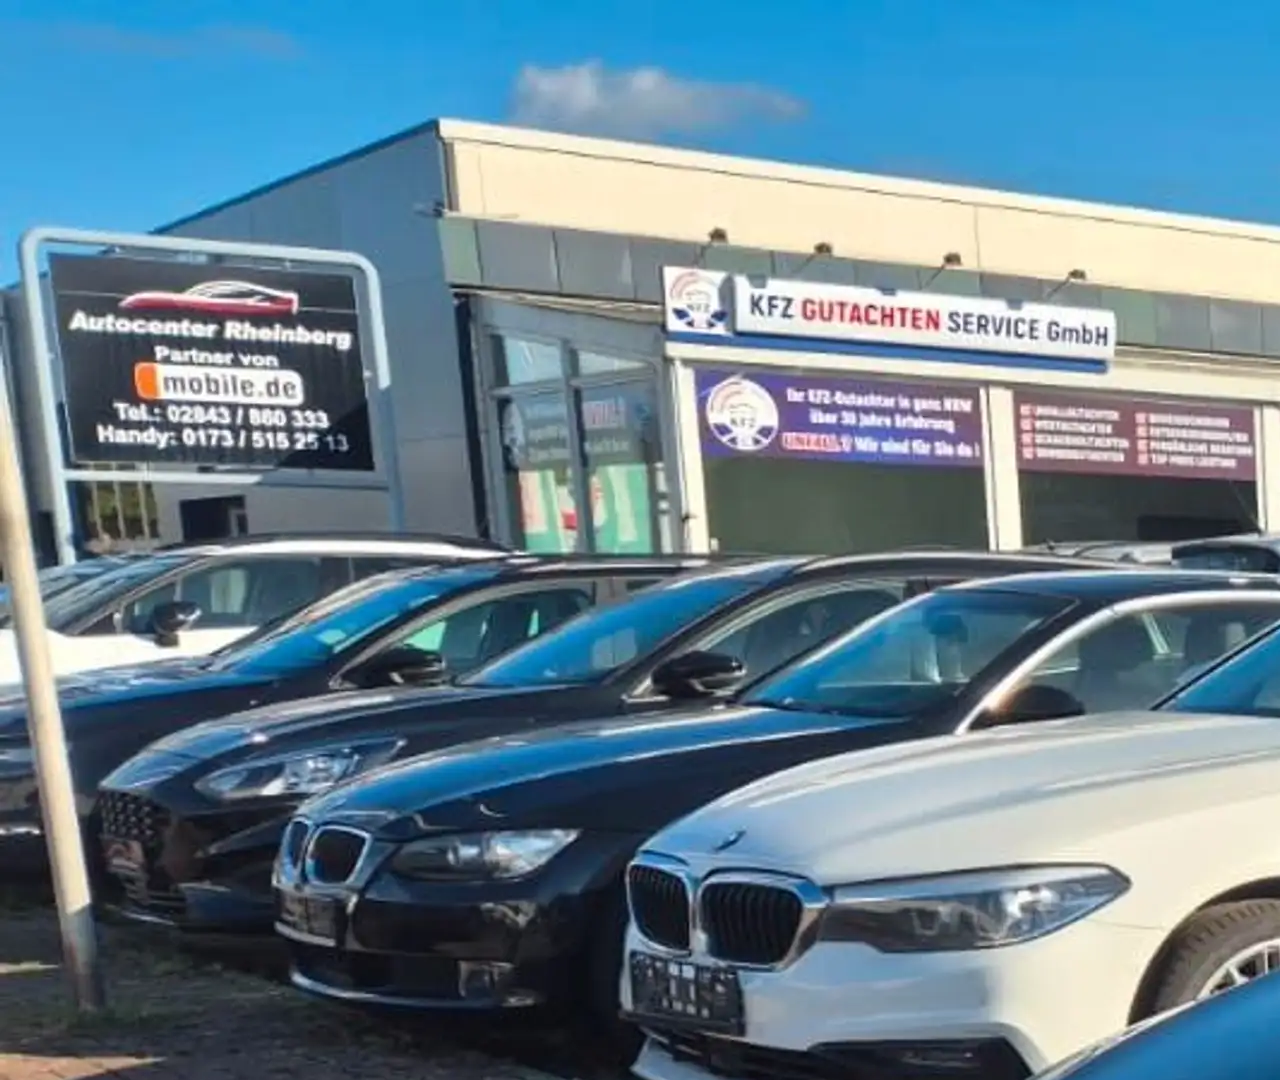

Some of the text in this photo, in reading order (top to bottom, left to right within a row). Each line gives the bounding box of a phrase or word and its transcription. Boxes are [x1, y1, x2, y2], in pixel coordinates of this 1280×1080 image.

[69, 309, 352, 350] Autocenter Rheinberg
[749, 293, 1109, 347] KFZ GUTACHTEN SERVICE GmbH
[153, 345, 279, 367] Partner von
[163, 374, 298, 399] mobile.de
[113, 402, 160, 423] Tel.:
[167, 405, 231, 425] 02843
[236, 407, 244, 427] /
[96, 425, 176, 449] Handy:
[182, 428, 234, 448] 0173
[251, 430, 289, 450] 515
[296, 431, 319, 450] 25
[325, 434, 349, 452] 13
